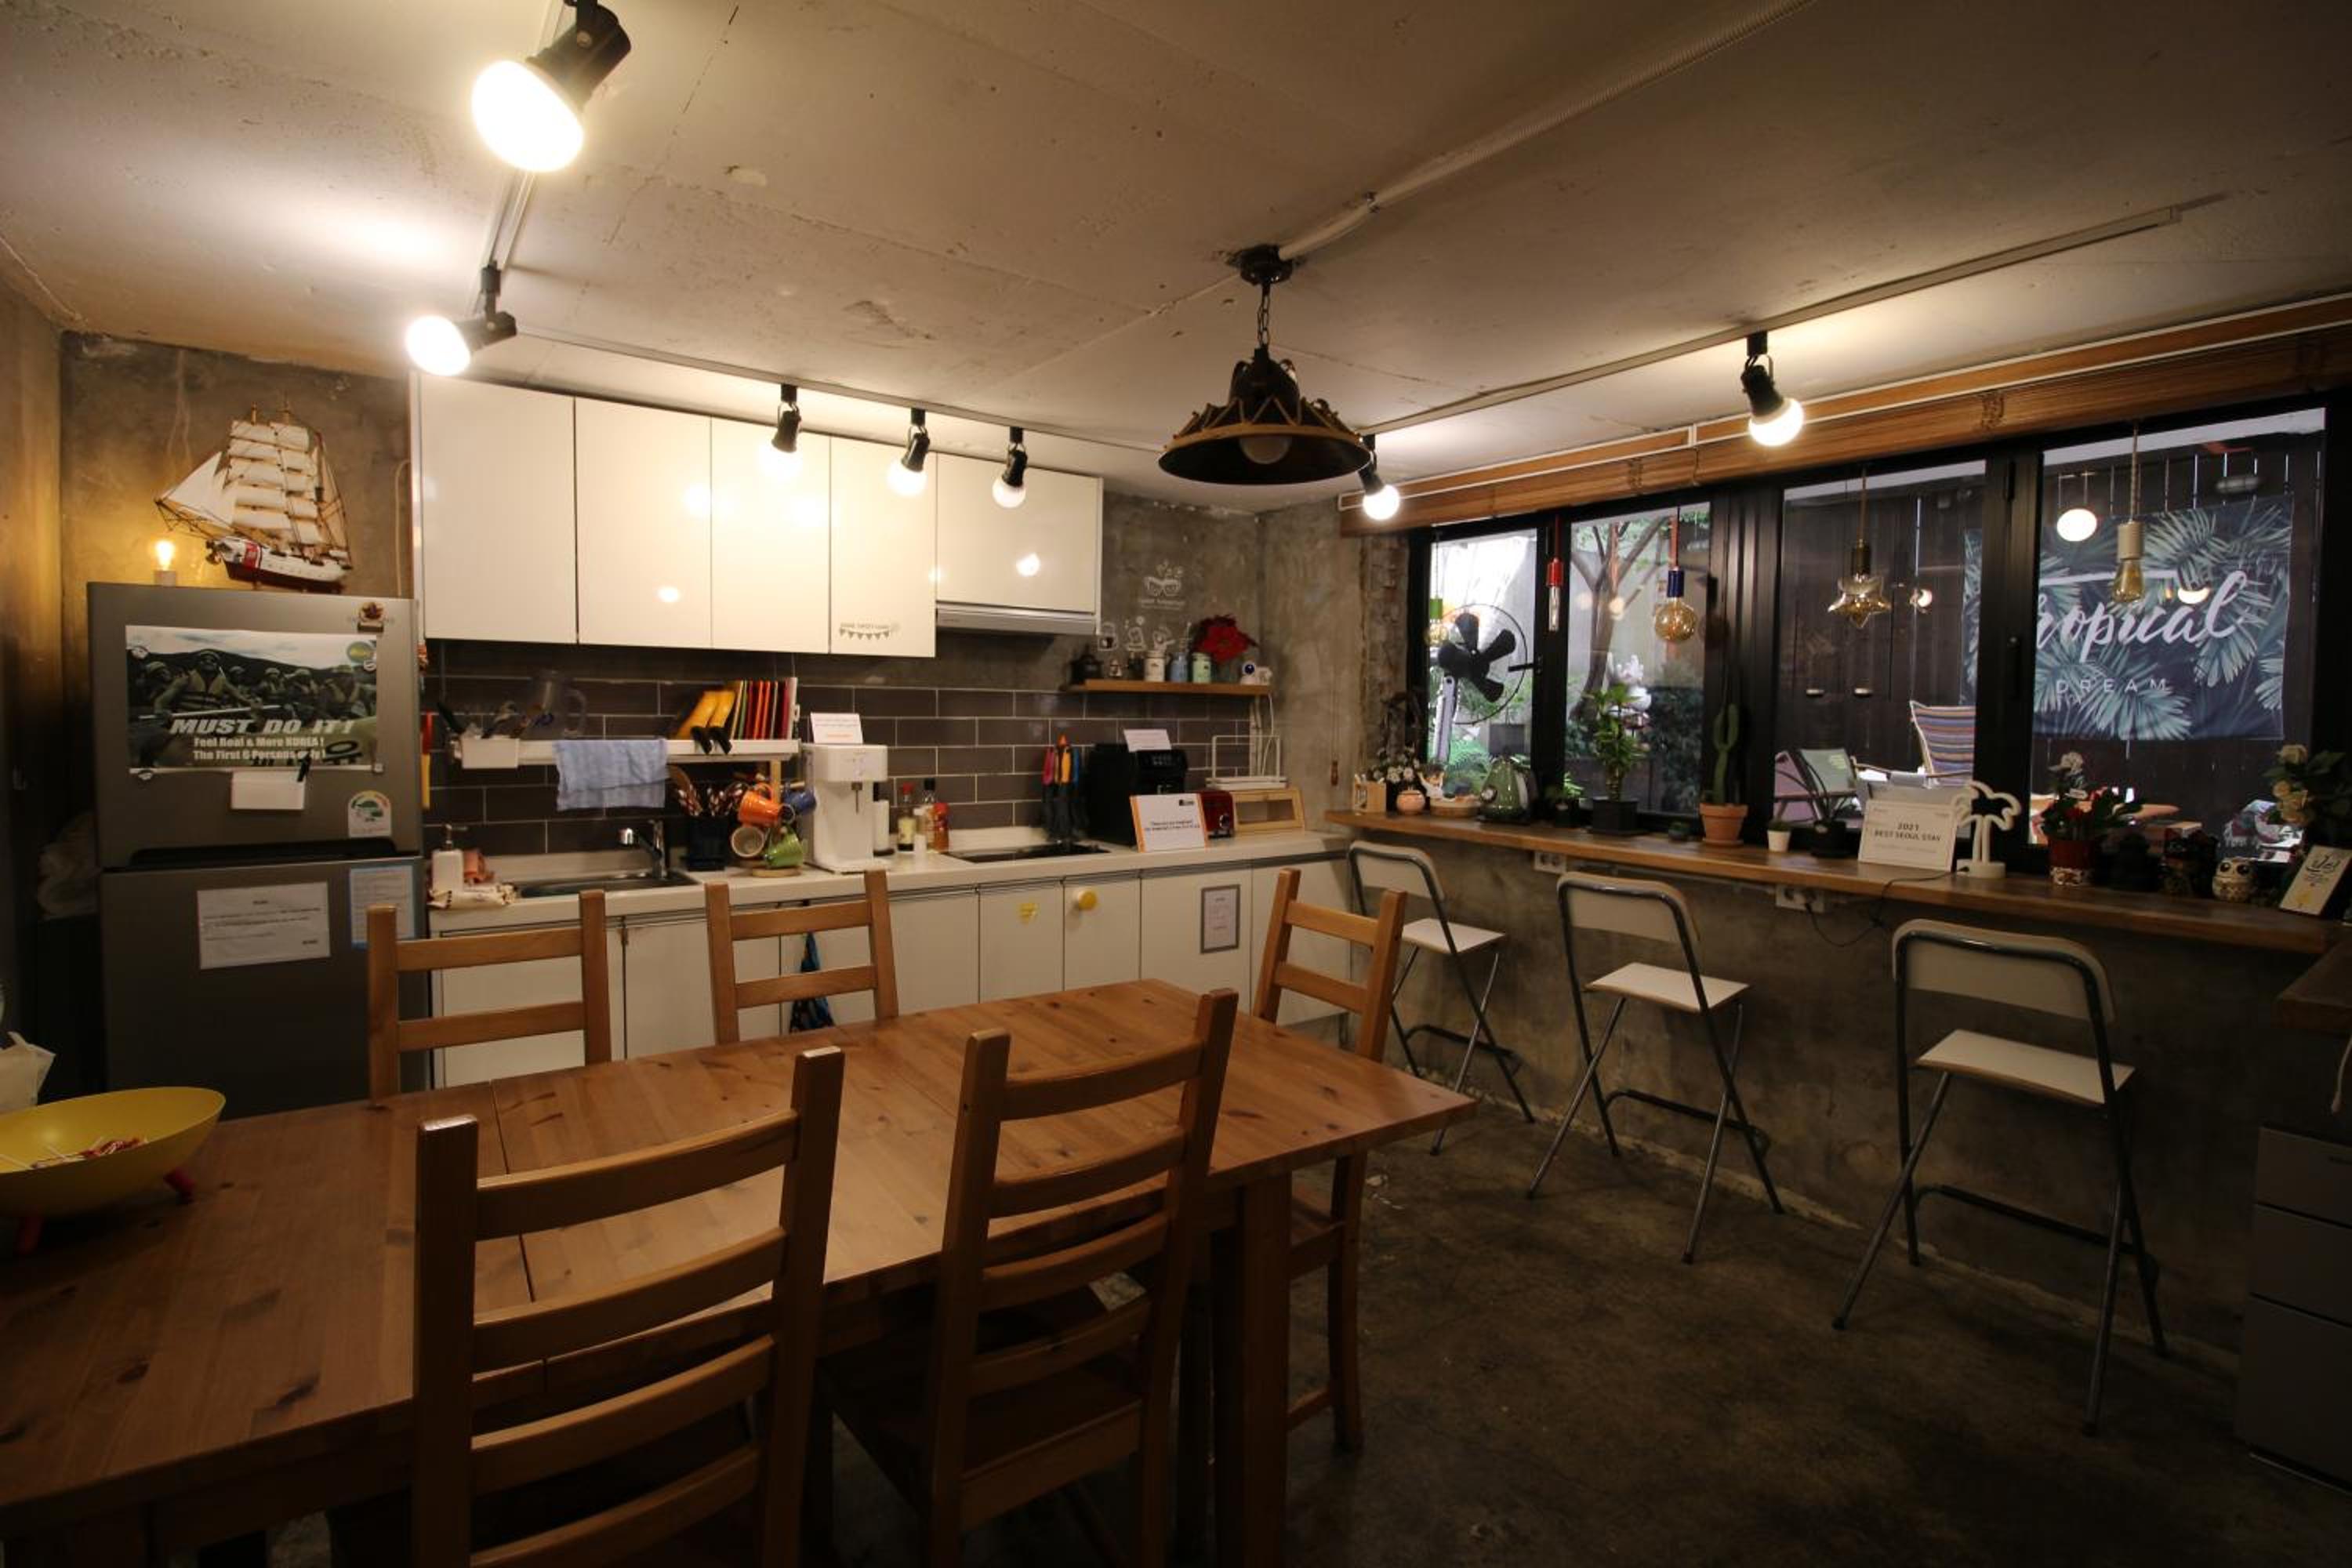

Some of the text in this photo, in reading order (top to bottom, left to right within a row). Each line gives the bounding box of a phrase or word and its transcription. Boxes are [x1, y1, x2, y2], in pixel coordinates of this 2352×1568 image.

[2037, 570, 2247, 662] ropical
[2056, 678, 2170, 693] DREAM
[169, 719, 255, 734] MUST
[262, 719, 302, 734] DO
[194, 737, 217, 747] Feel
[219, 737, 244, 747] Real
[255, 737, 284, 747] More
[193, 750, 214, 760] The
[216, 750, 241, 760] First
[1875, 829, 1893, 838] BEST
[1895, 832, 1919, 840] SEOUL
